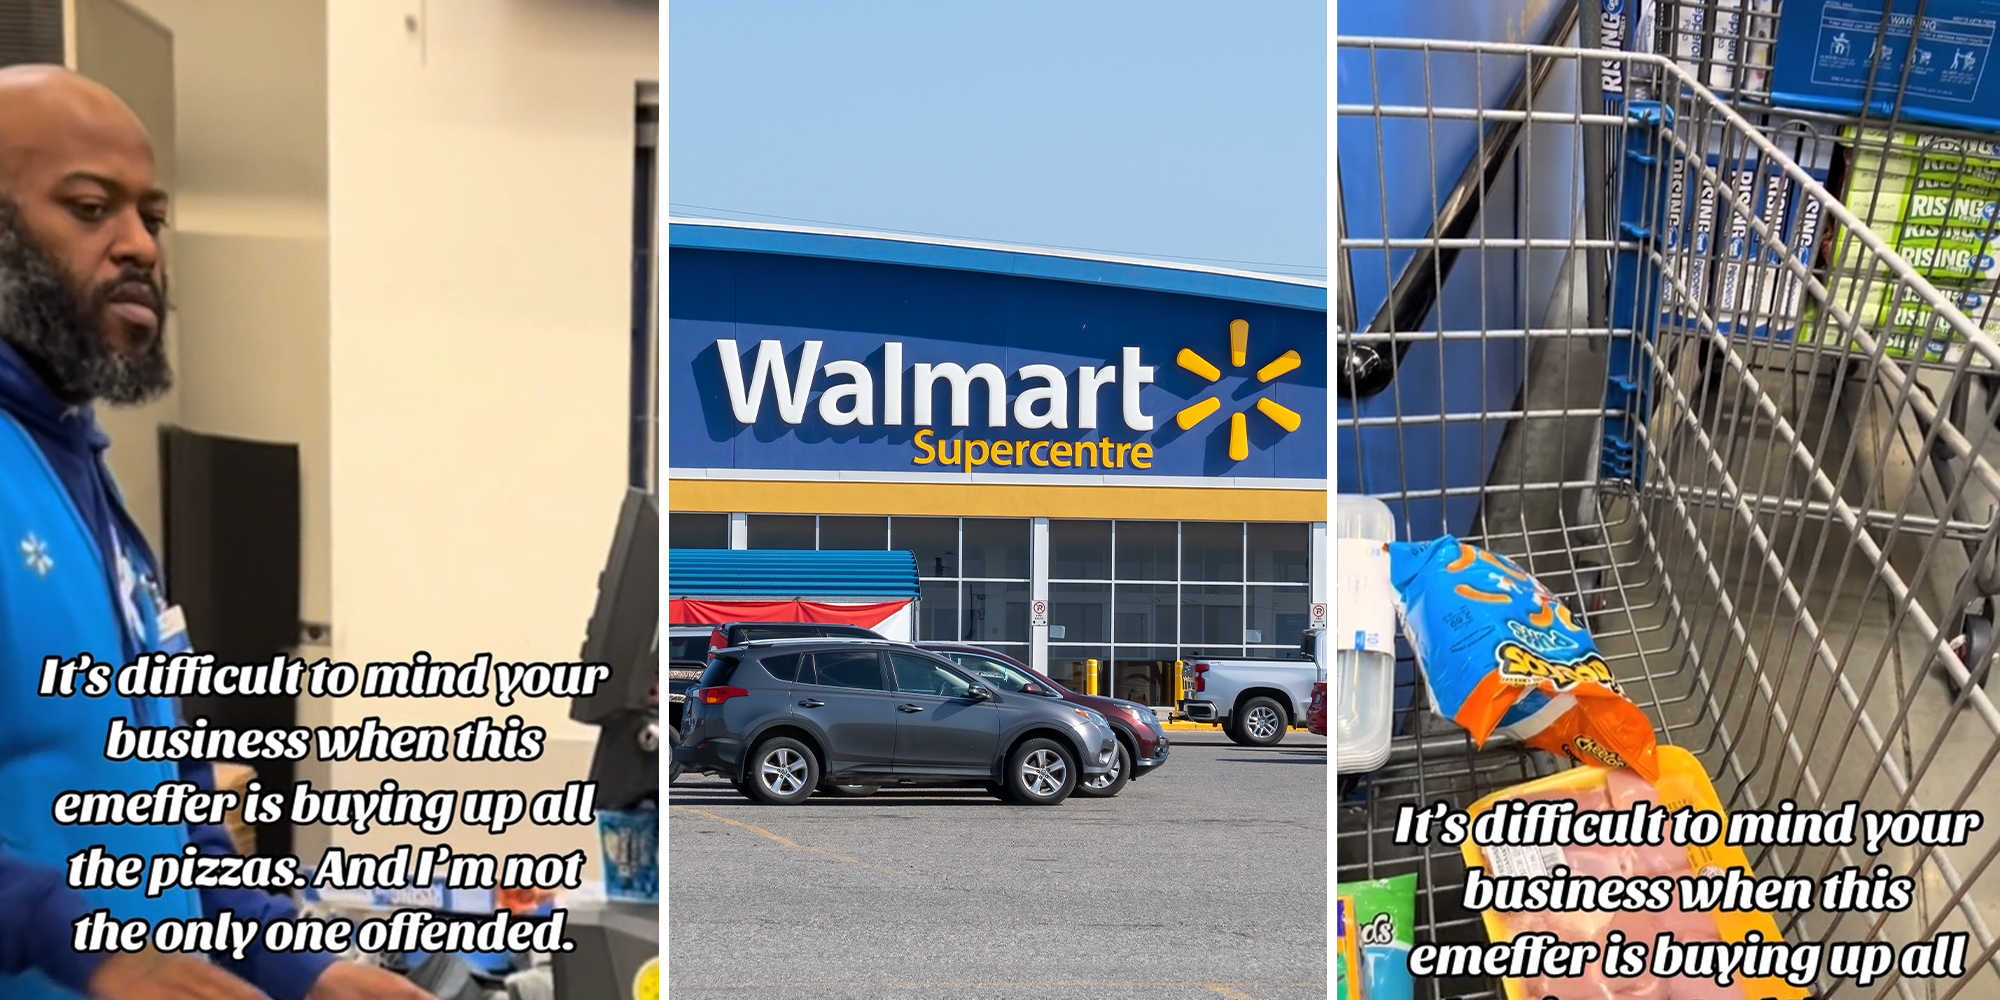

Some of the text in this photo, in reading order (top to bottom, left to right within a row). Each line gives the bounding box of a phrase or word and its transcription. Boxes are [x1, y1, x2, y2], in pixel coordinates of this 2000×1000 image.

[1890, 15, 1937, 30] WARNG
[1911, 195, 1984, 220] RISING
[1901, 246, 1971, 269] RISING
[717, 338, 1155, 431] Walmart
[913, 429, 1154, 473] Supercentre
[1366, 632, 1379, 645] 10
[1359, 913, 1395, 946] ds
